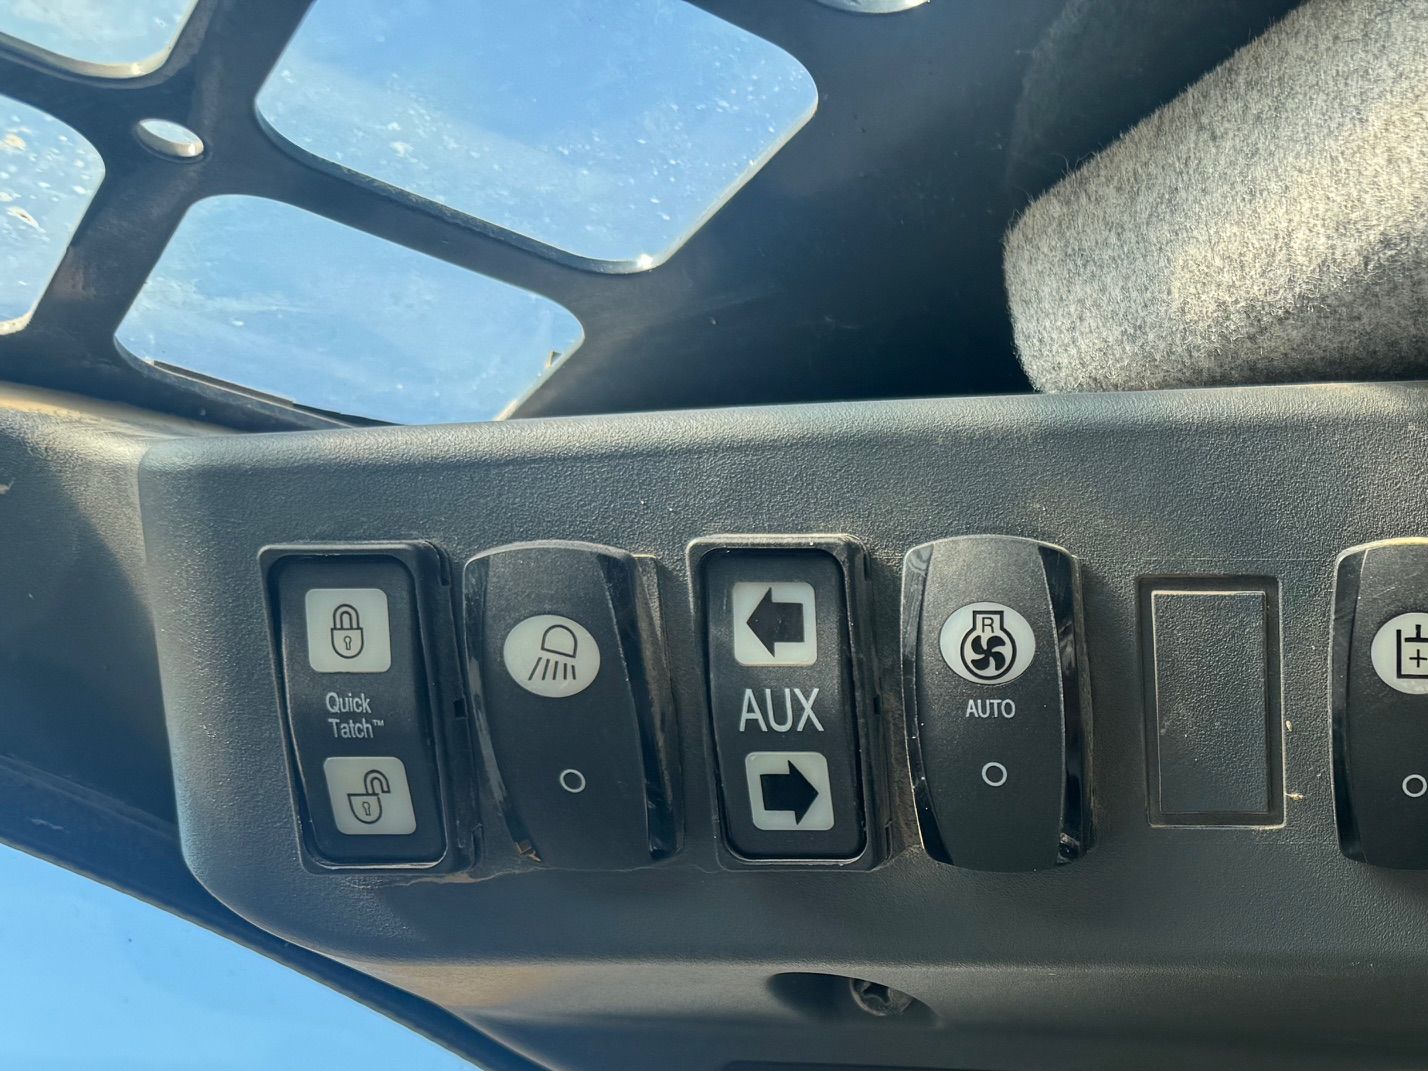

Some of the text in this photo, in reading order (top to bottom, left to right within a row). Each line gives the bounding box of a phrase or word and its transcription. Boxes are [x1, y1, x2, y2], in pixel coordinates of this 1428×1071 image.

[981, 617, 994, 634] R
[325, 692, 372, 714] Quick
[739, 688, 824, 732] AUX
[965, 699, 1016, 719] AUTO
